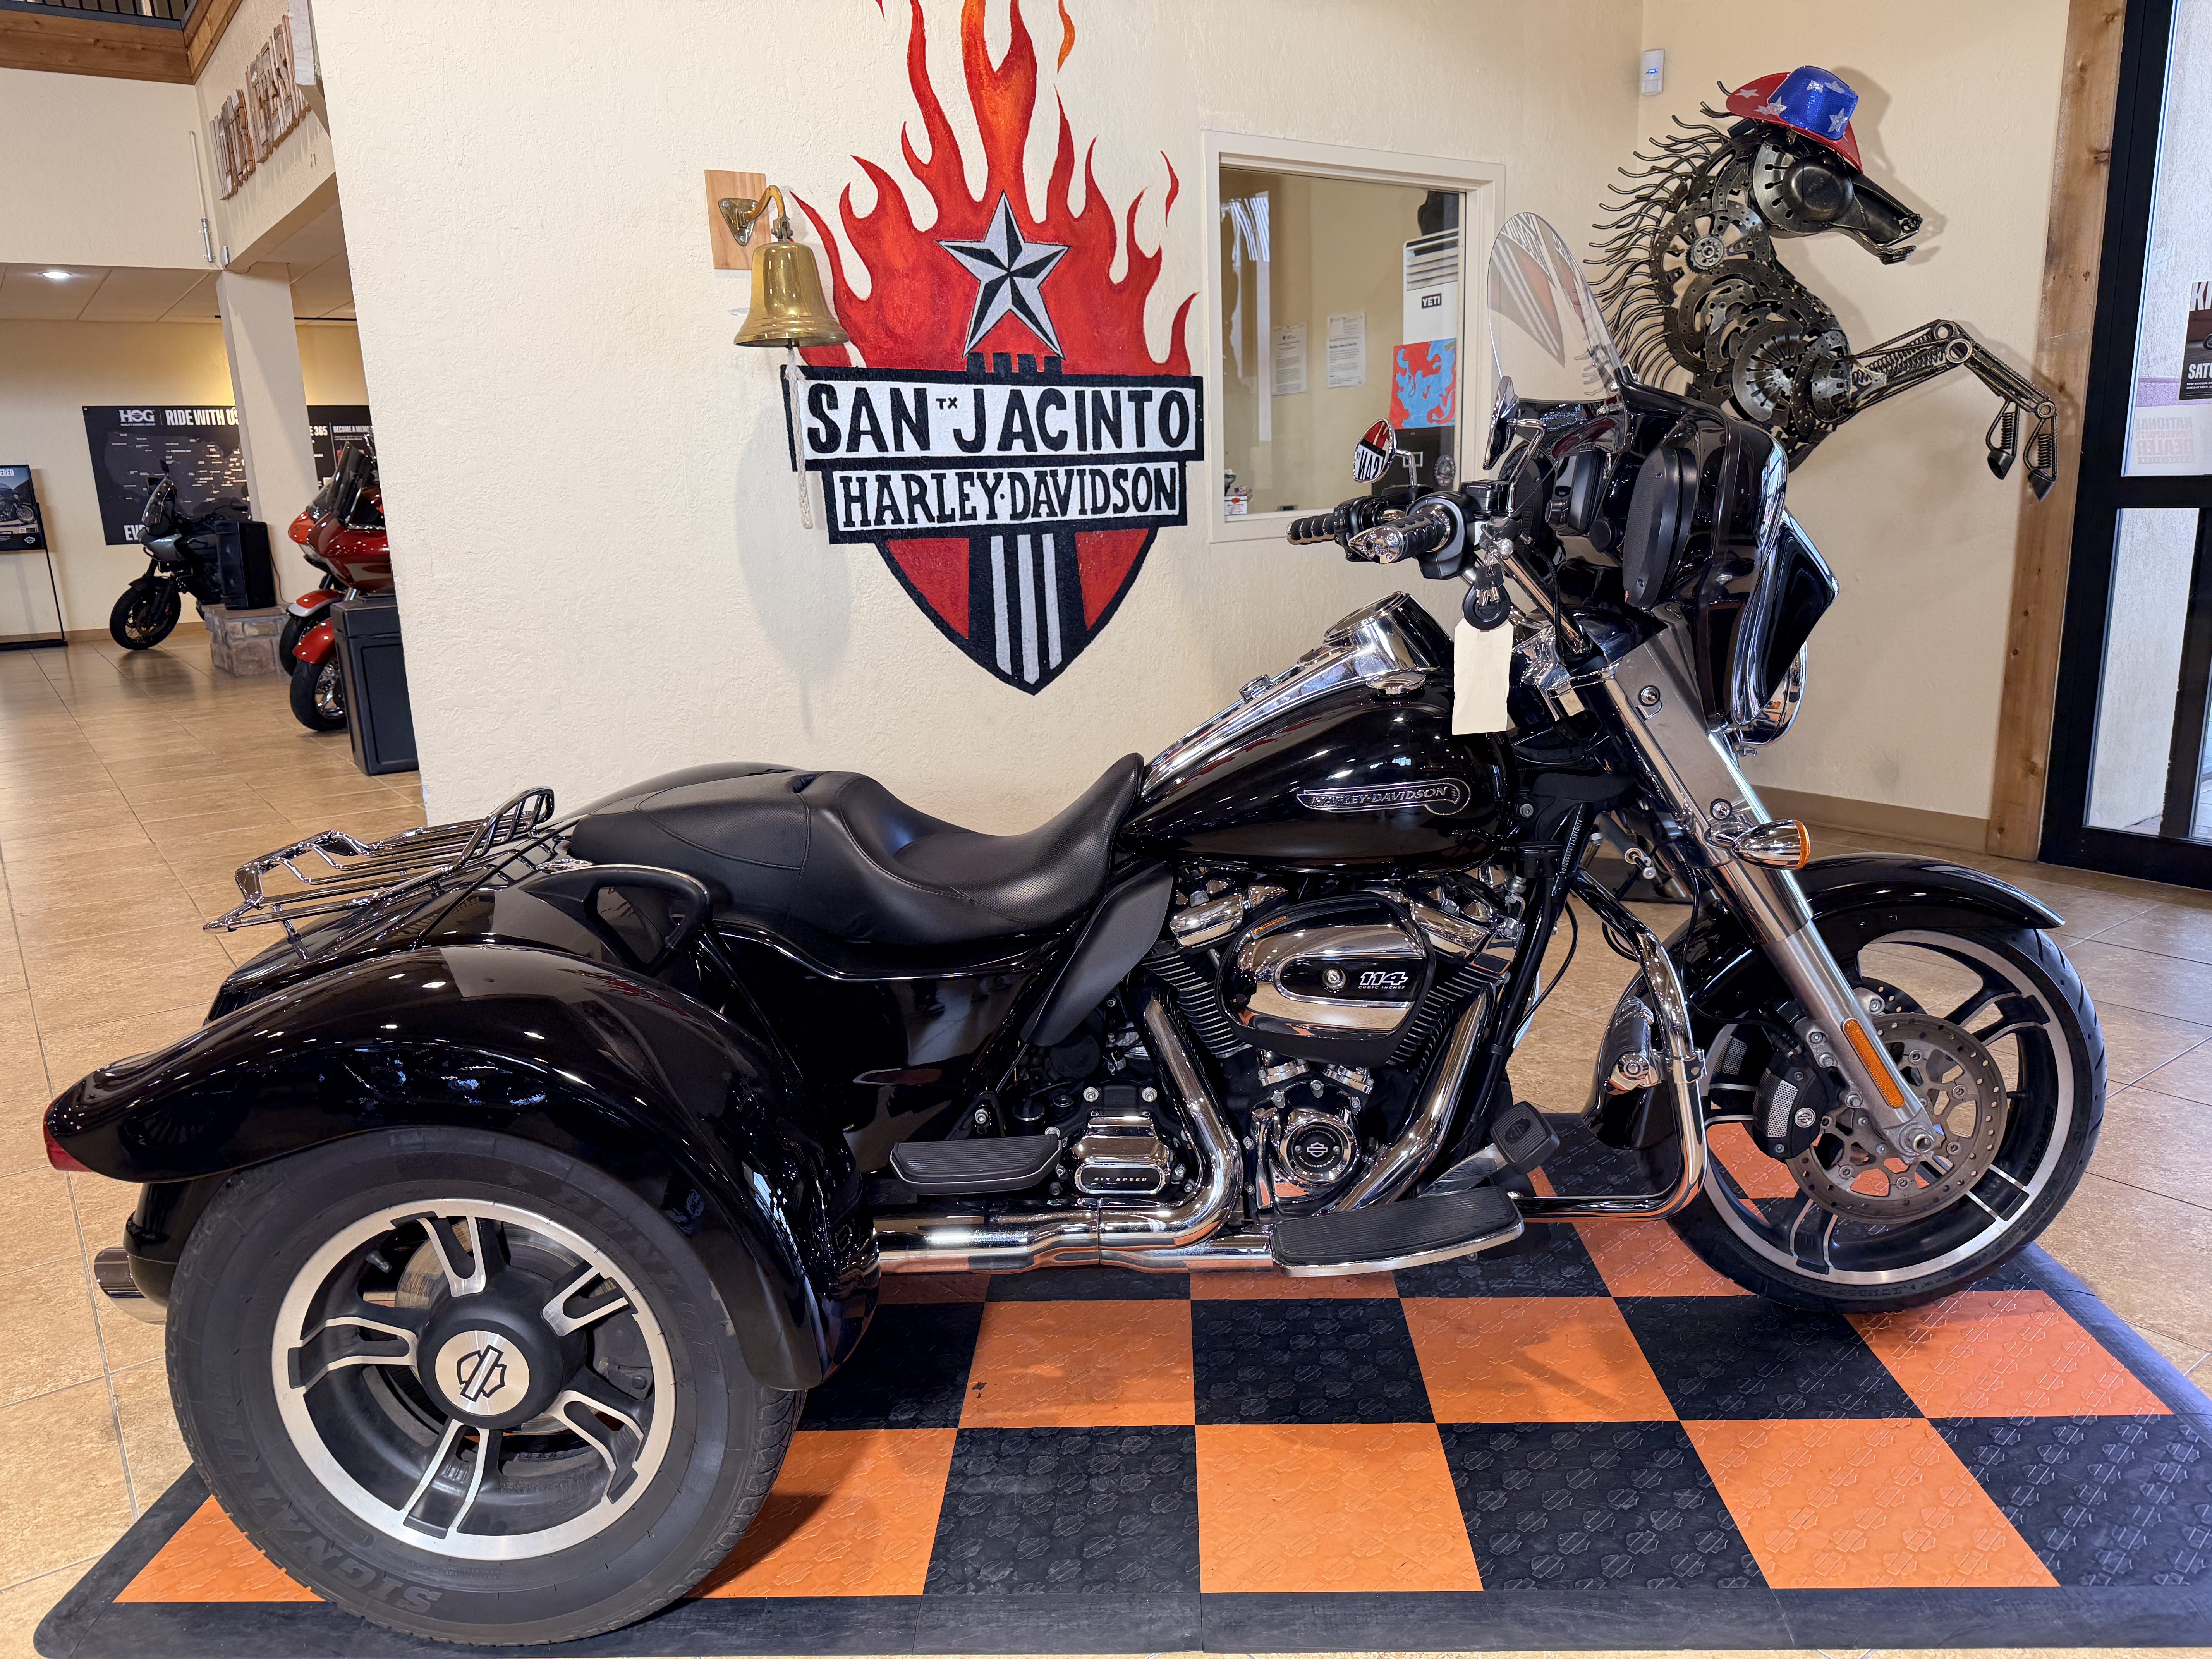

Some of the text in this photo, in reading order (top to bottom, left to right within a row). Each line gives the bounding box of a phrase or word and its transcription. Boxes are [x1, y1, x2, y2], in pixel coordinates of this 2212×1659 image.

[1422, 295, 1441, 307] YETI
[165, 410, 194, 426] RIDE
[194, 410, 225, 426] WITH
[807, 383, 1189, 453] SAN TX JACINTO
[314, 426, 328, 436] 365
[1360, 972, 1408, 986] 114
